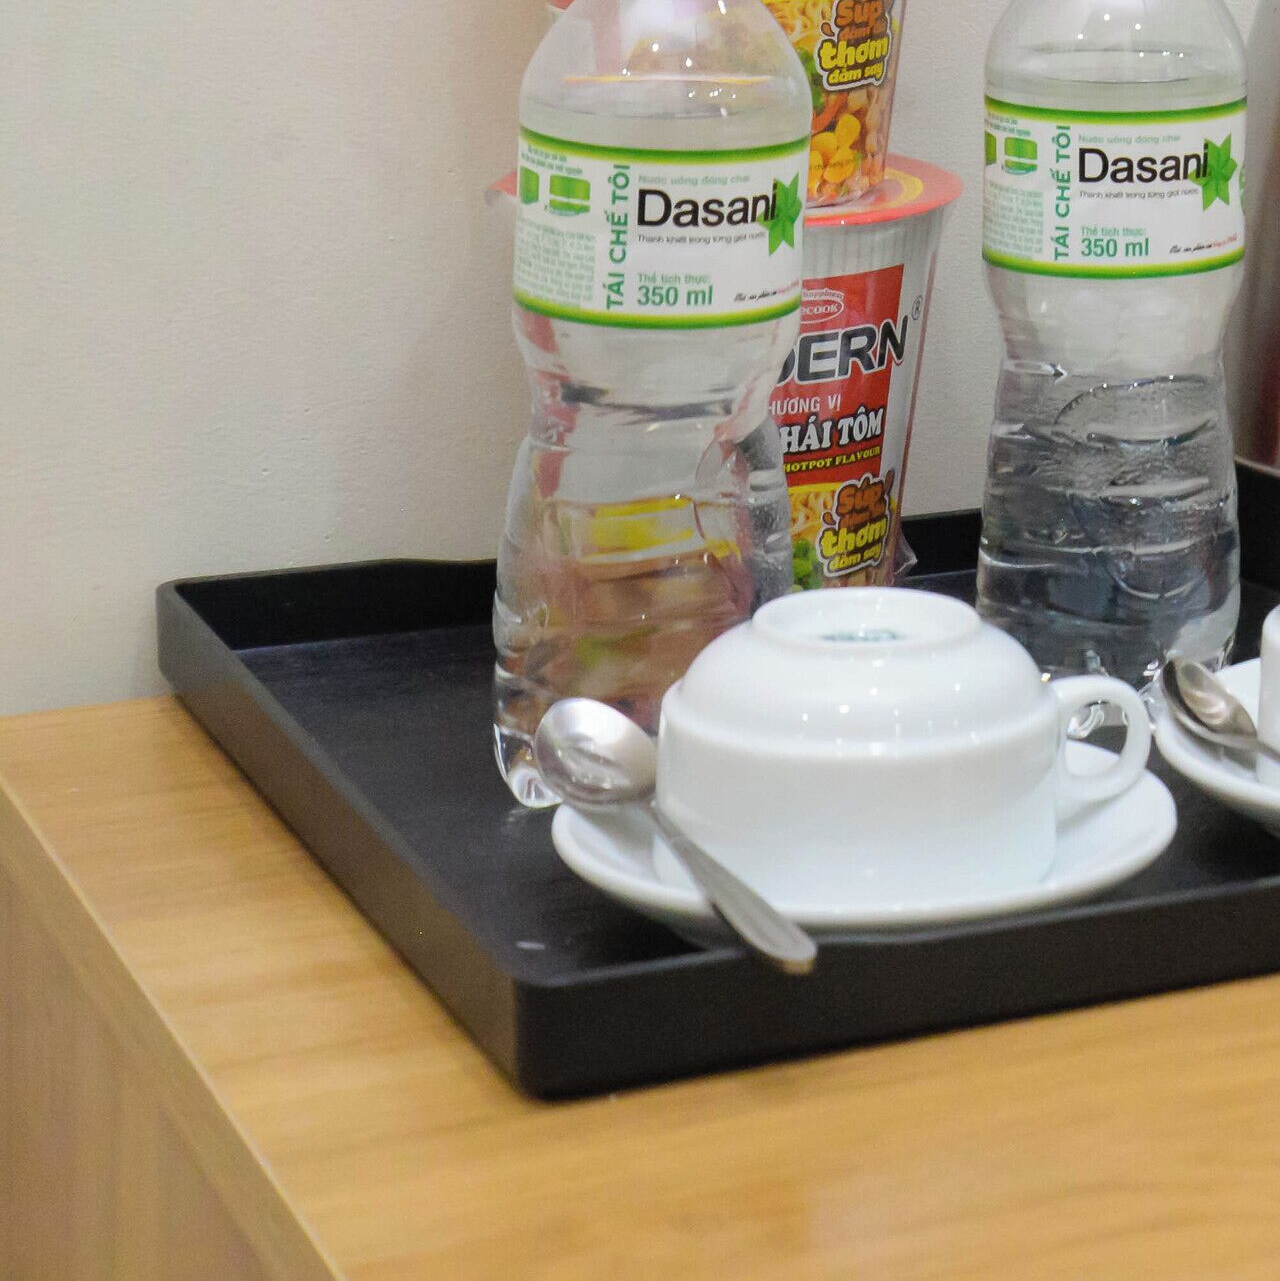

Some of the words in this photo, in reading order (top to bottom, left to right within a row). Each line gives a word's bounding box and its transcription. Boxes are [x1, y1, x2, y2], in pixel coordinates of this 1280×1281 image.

[1052, 125, 1071, 163] TÔI
[1079, 142, 1209, 184] Dasani
[608, 164, 631, 205] TÔI
[637, 178, 777, 227] Dasani
[1049, 168, 1071, 218] CHẾ
[604, 210, 628, 264] CHẾ
[1051, 226, 1069, 261] TÁI
[1081, 238, 1118, 258] 350
[1125, 237, 1149, 257] ml
[603, 272, 625, 310] TÁI
[637, 285, 679, 306] 350
[686, 284, 714, 306] ml
[828, 394, 842, 411] VỊ
[780, 416, 832, 454] HÁI
[837, 406, 884, 445] TÔM
[836, 446, 881, 466] FLAVOUR
